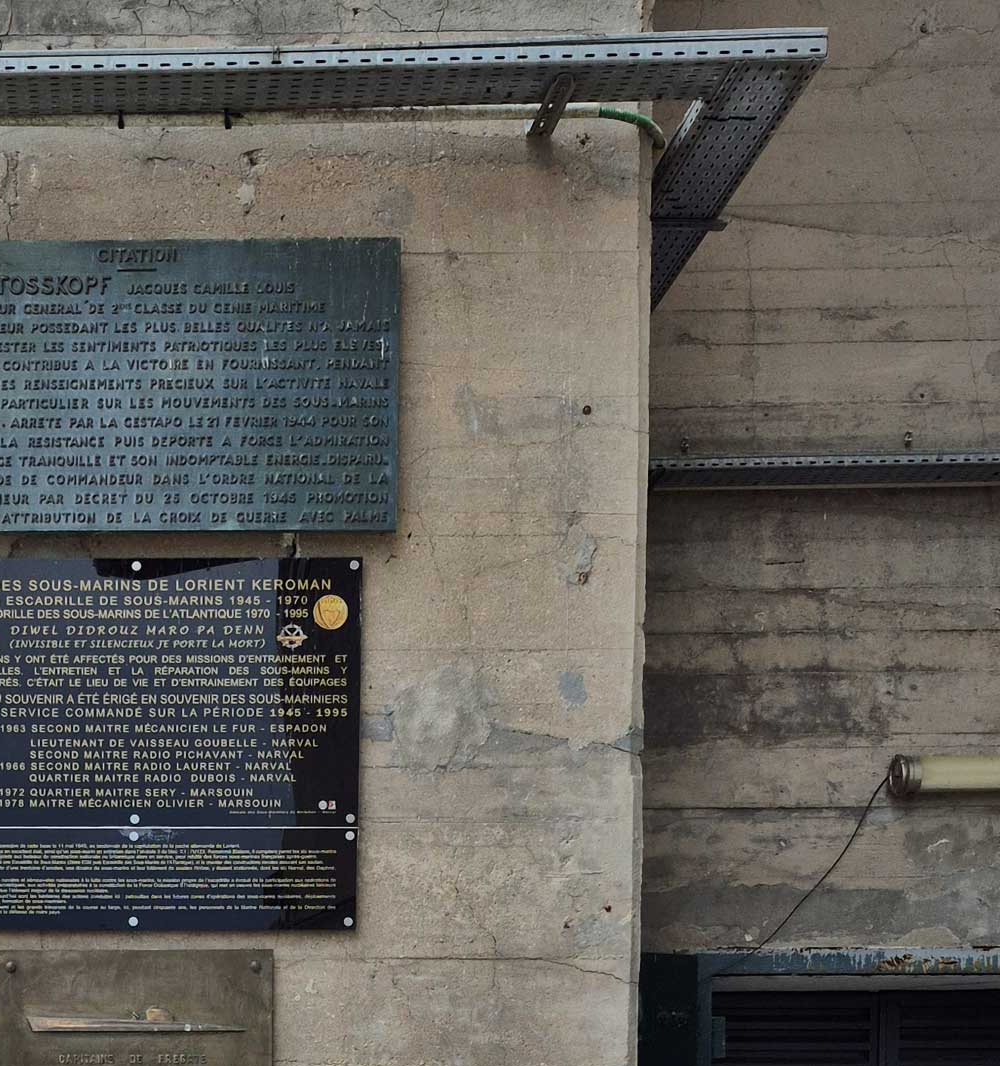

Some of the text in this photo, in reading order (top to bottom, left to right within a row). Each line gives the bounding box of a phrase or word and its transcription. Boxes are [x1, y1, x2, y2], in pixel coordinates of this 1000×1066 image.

[97, 248, 177, 264] CITATION
[127, 282, 187, 295] JACQUES
[194, 282, 249, 295] CAMILLE
[256, 283, 295, 294] LOUIS
[88, 303, 105, 315] DE
[134, 302, 181, 314] CLASSE
[189, 303, 206, 314] DU
[258, 302, 326, 314] MARITIME
[1, 398, 89, 410] PARTICULIER
[97, 398, 122, 410] SUR
[130, 397, 154, 409] LES
[161, 397, 255, 409] MOUVEMENTS
[263, 397, 287, 408] DES
[21, 474, 38, 487] DE
[47, 474, 143, 487] COMMANDEUR
[153, 474, 192, 487] DANS
[199, 474, 255, 485] L'ORDRE
[265, 474, 335, 487] NATIONAL
[344, 474, 360, 485] DE
[370, 474, 388, 485] LA
[107, 512, 122, 523] DE
[128, 512, 151, 523] LA
[160, 511, 201, 523] CROIX
[211, 512, 227, 523] DE
[237, 512, 287, 523] GUERRE
[299, 512, 334, 523] AVEC
[345, 512, 389, 523] PALME
[29, 580, 141, 591] SOUS-MARINS
[148, 579, 168, 591] DE
[176, 579, 245, 591] LORIENT
[252, 579, 331, 592] KEROMAN
[6, 596, 93, 605] ESCADRILLE
[100, 596, 118, 605] DE
[124, 595, 222, 605] SOUS-MARINS
[230, 596, 260, 605] 1945
[277, 596, 308, 605] 1970
[37, 609, 60, 619] DES
[63, 609, 141, 619] SOUS-MARINS
[145, 609, 160, 618] DE
[163, 609, 242, 619] L'ATLANTIQUE
[246, 609, 271, 619] 1970
[284, 609, 310, 618] 1995
[10, 625, 263, 635] DIWEL DIDROUZ MARO PA DENN
[10, 639, 265, 649] (INVISIBLE ET SILENCIEUX JE PORTE LA MORT)
[5, 694, 63, 704] SOUVENIR
[67, 694, 74, 704] A
[78, 693, 99, 704] ÉTÉ
[103, 693, 138, 704] ÉRIGÉ
[141, 694, 157, 704] EN
[160, 694, 219, 704] SOUVENIR
[223, 694, 245, 704] DES
[249, 693, 348, 705] SOUS-MARINIERS
[1, 708, 59, 717] SERVICE
[65, 707, 142, 718] COMMANDÉ
[149, 708, 175, 717] SUR
[182, 708, 197, 717] LA
[204, 707, 263, 717] PÉRIODE
[270, 707, 301, 717] 1945
[316, 708, 347, 717] 1995
[32, 724, 80, 733] SECOND
[85, 724, 129, 733] MAITRE
[135, 723, 207, 733] MÉCANICIEN
[213, 724, 227, 732] LE
[232, 724, 255, 733] FUR
[270, 724, 326, 733] ESPADON
[31, 739, 318, 748] LIEUTENANT DE VAISSEAU GOUBELLE NARVAL
[30, 750, 304, 760] SECOND MAITRE RADIO PICHAVANT NARVAL
[31, 762, 79, 770] SECOND
[85, 762, 128, 771] MAITRE
[134, 762, 171, 770] RADIO
[177, 762, 231, 770] LAURENT
[245, 762, 291, 771] NARVAL
[29, 773, 296, 782] QUARTIER MAITRE RADIO DUBOIS NARVAL
[30, 788, 90, 797] QUARTIER
[96, 788, 139, 797] MAITRE
[145, 788, 176, 797] SERY
[190, 788, 253, 797] MARSOUIN
[30, 799, 73, 808] MAITRE
[79, 799, 151, 807] MÉCANICIEN
[157, 799, 204, 807] OLIVIER
[218, 799, 281, 808] MARSOUIN
[129, 1054, 144, 1065] DE
